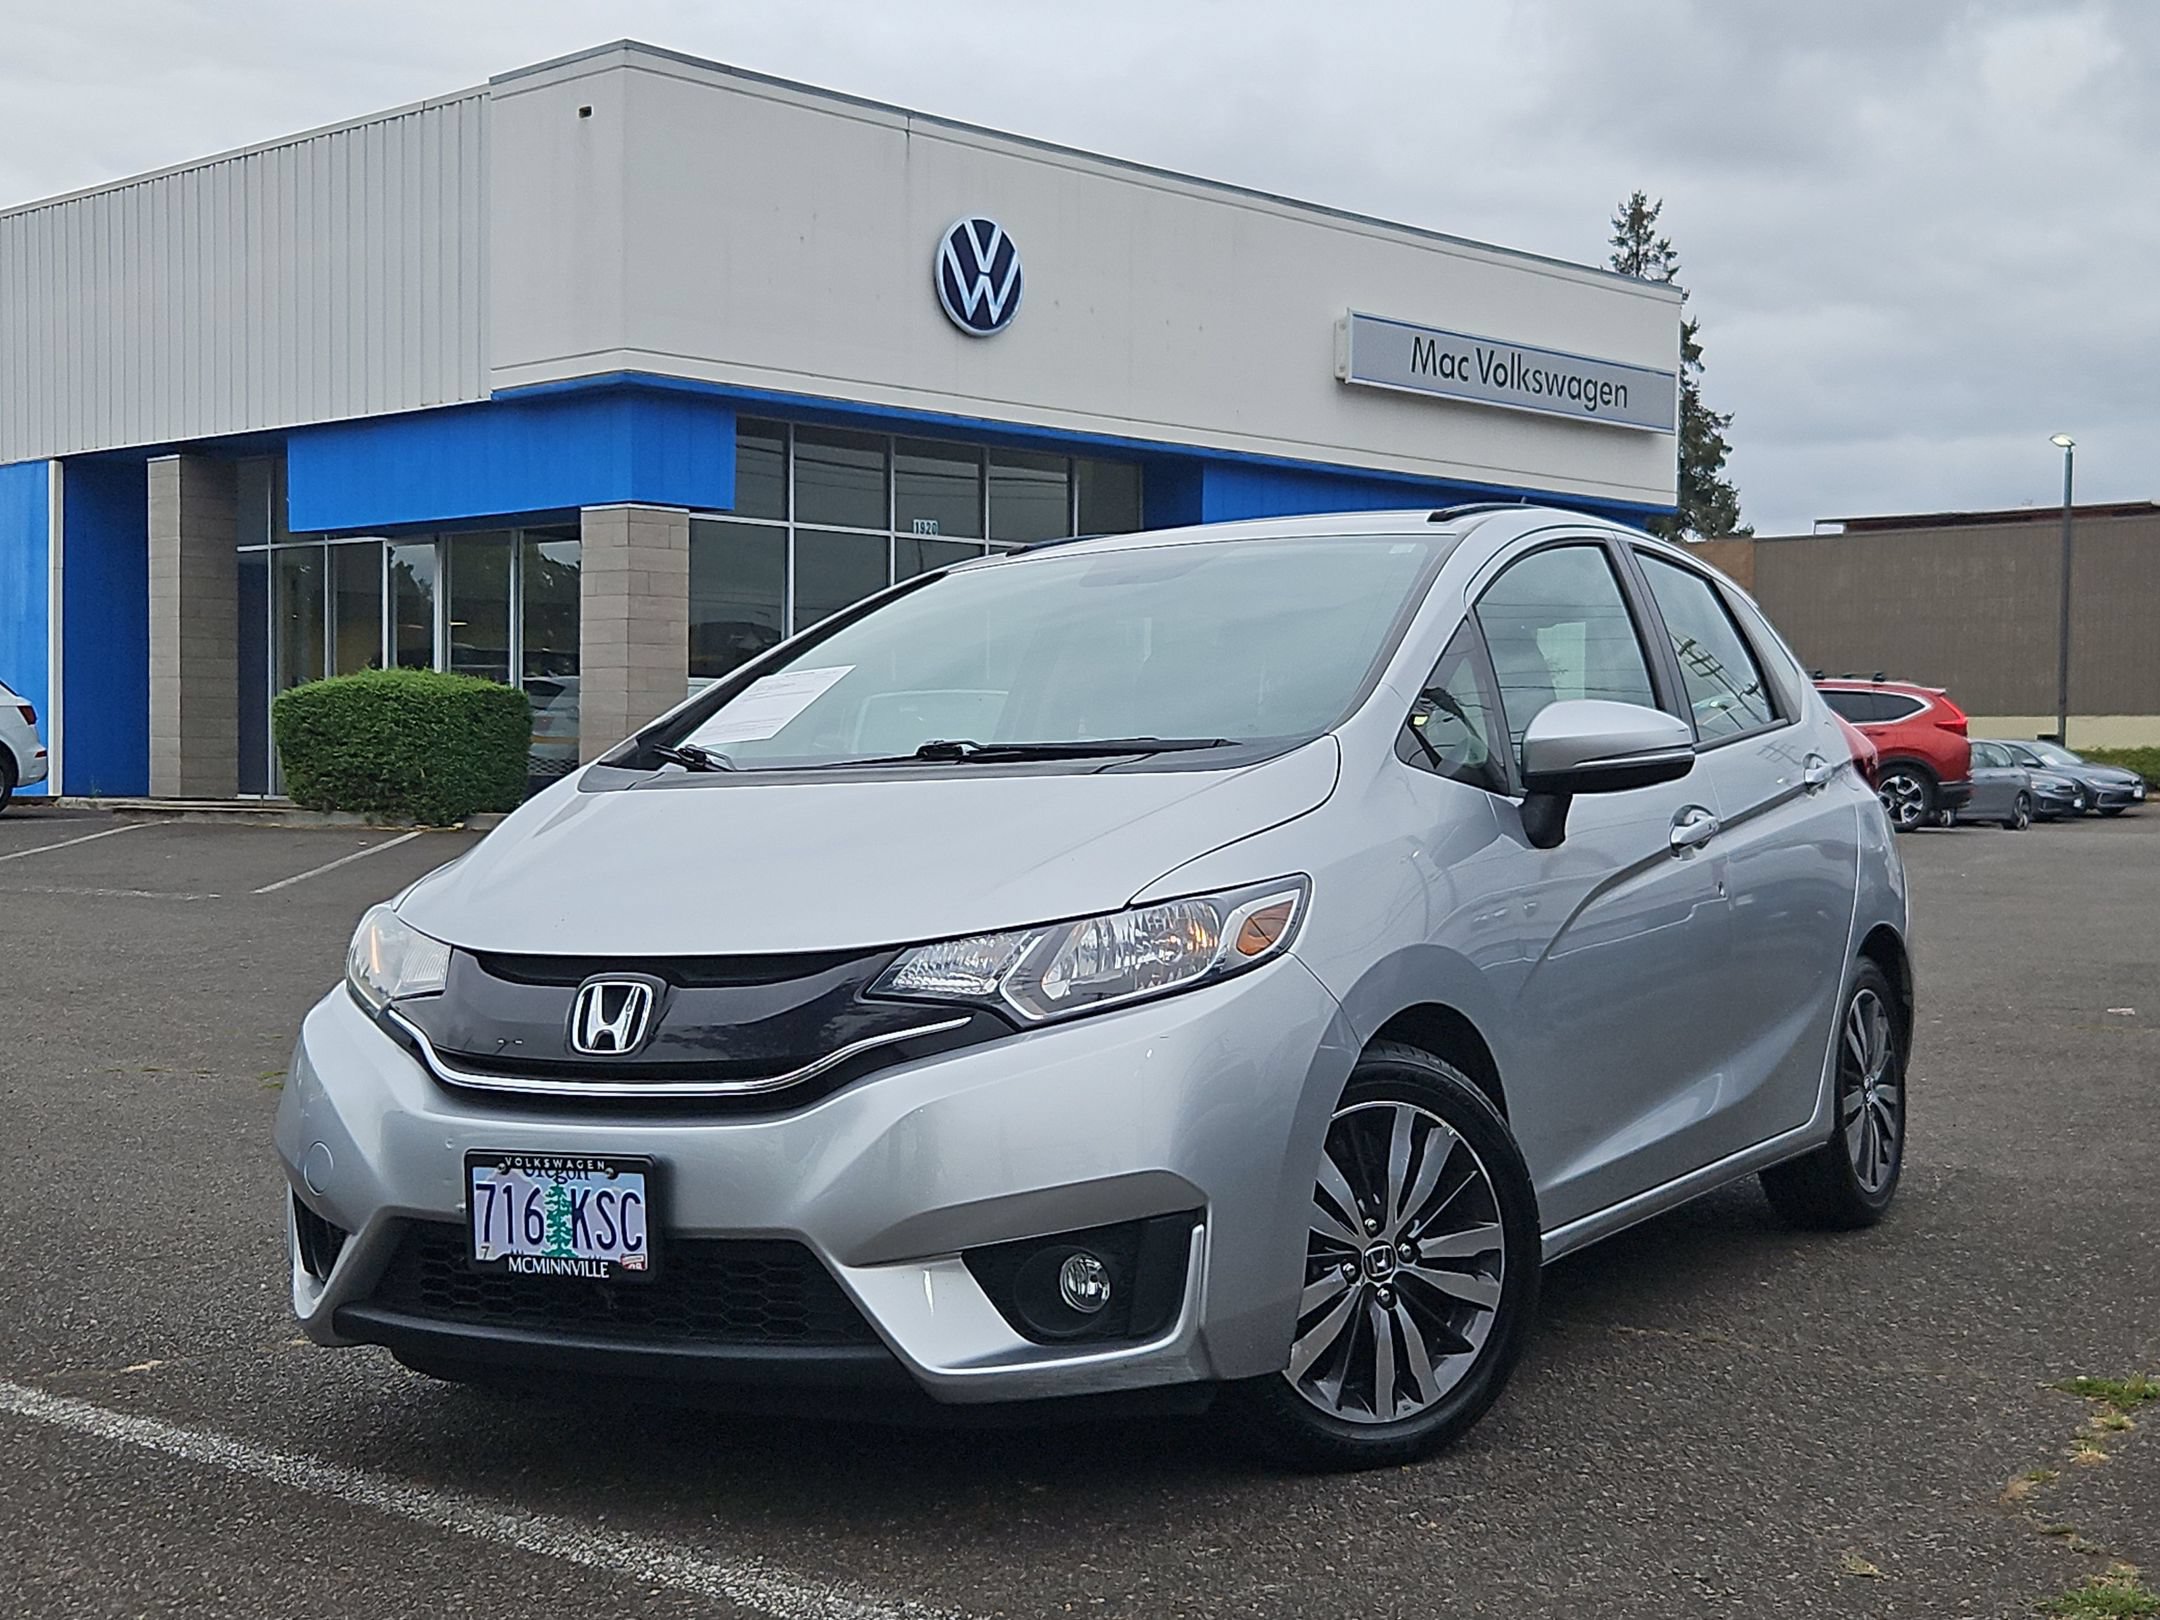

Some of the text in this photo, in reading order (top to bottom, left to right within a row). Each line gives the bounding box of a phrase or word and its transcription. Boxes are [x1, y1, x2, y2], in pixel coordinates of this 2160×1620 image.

[1411, 336, 1627, 411] Mac Volkswagen
[915, 521, 938, 536] 1920
[505, 1157, 605, 1170] VOLKSWAGEN
[476, 1184, 643, 1251] 716 KSC
[508, 1256, 610, 1279] MCMINNVILLE
